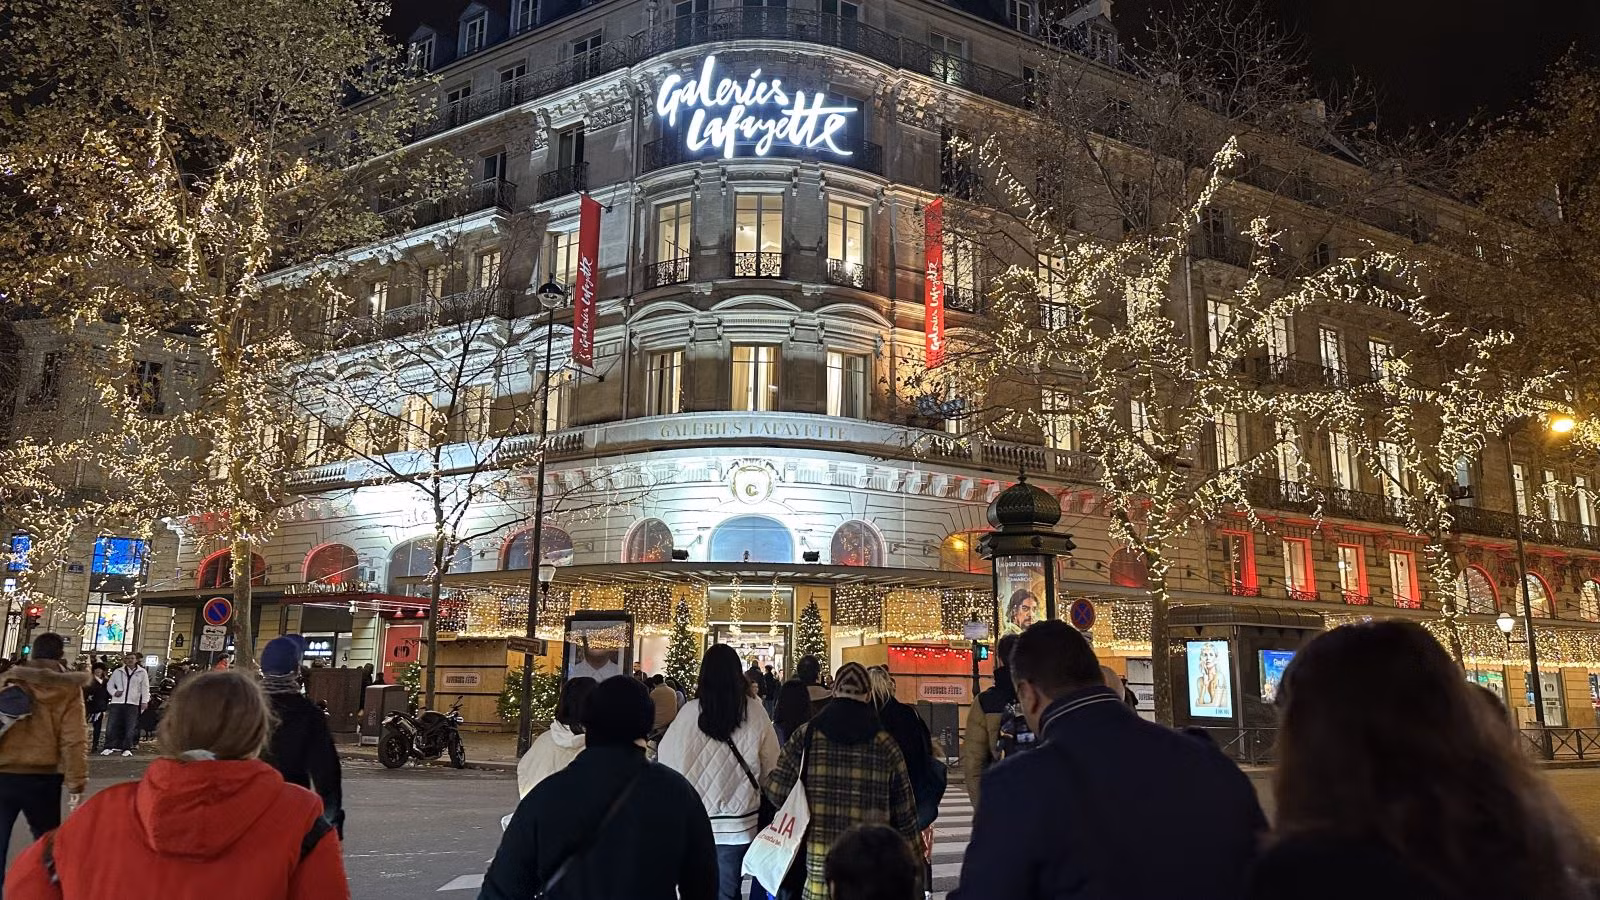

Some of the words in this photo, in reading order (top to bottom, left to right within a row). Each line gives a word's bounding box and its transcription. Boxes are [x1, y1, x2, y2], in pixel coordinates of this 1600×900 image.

[657, 55, 789, 127] Galeries
[686, 91, 858, 159] Lafayette
[660, 421, 742, 438] GALERIES
[749, 421, 845, 439] LAFAYETTE
